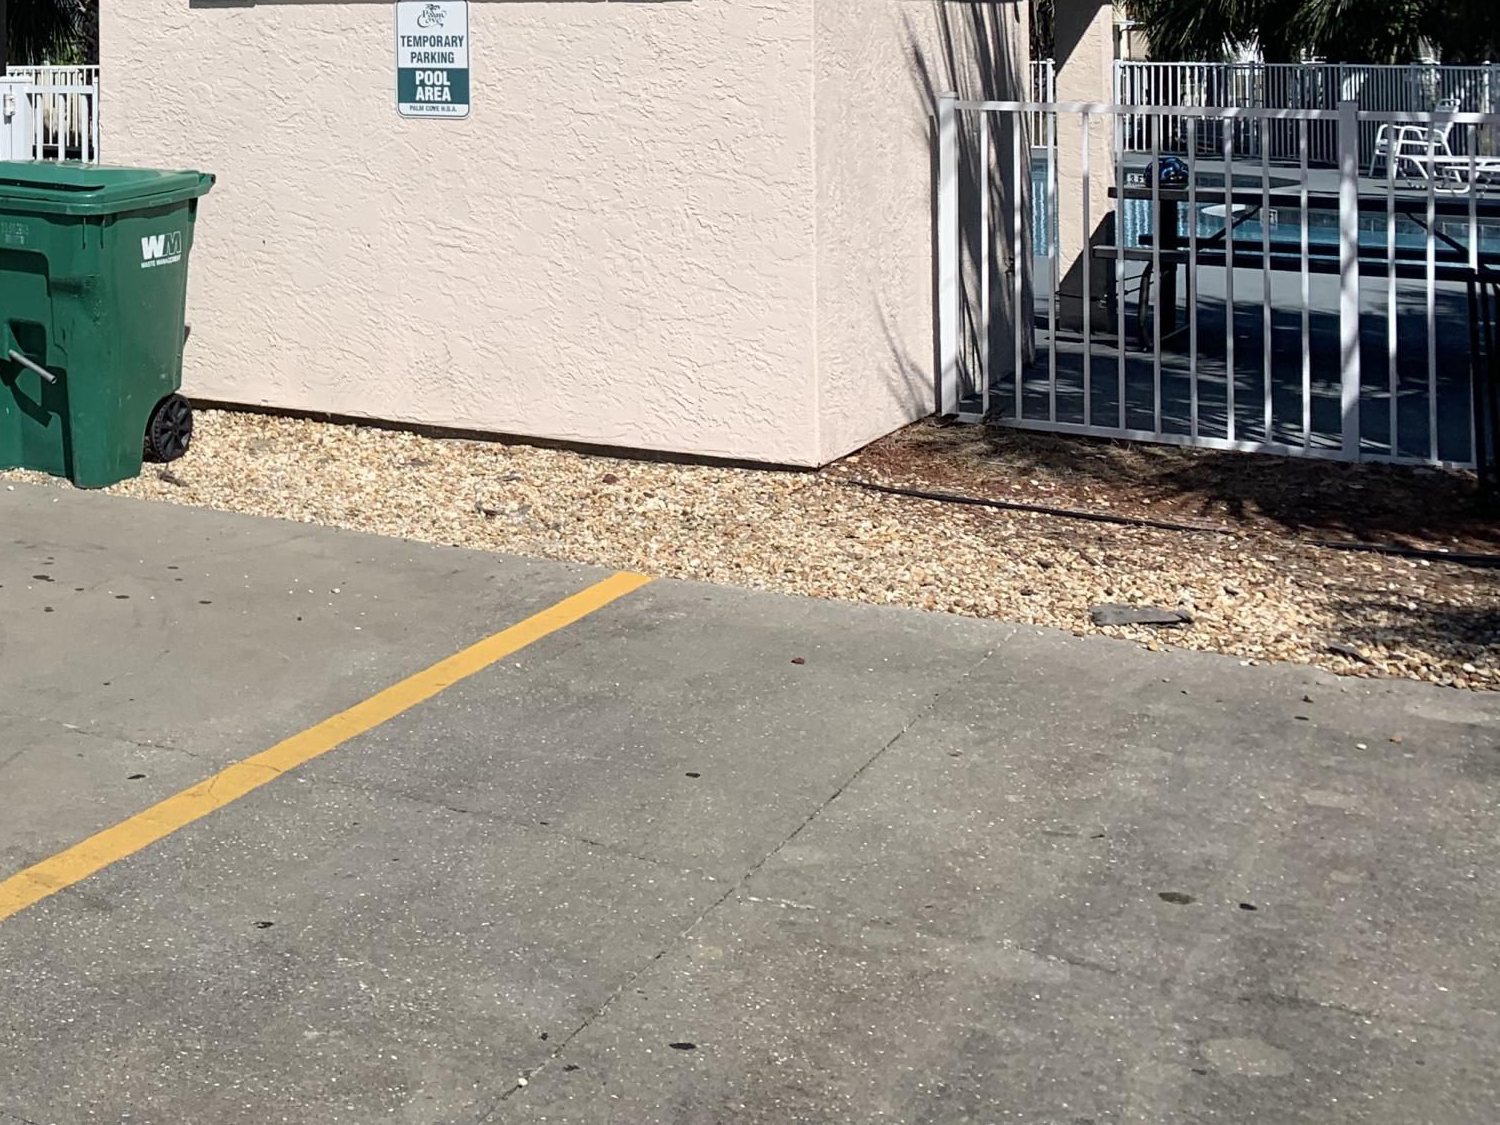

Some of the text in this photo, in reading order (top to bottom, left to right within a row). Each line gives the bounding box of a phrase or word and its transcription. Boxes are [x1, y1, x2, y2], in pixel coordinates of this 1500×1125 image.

[400, 35, 464, 48] TEMPORARY
[410, 51, 455, 64] PARKING
[415, 70, 451, 86] POOL
[415, 86, 452, 101] AREA
[141, 231, 181, 260] WM
